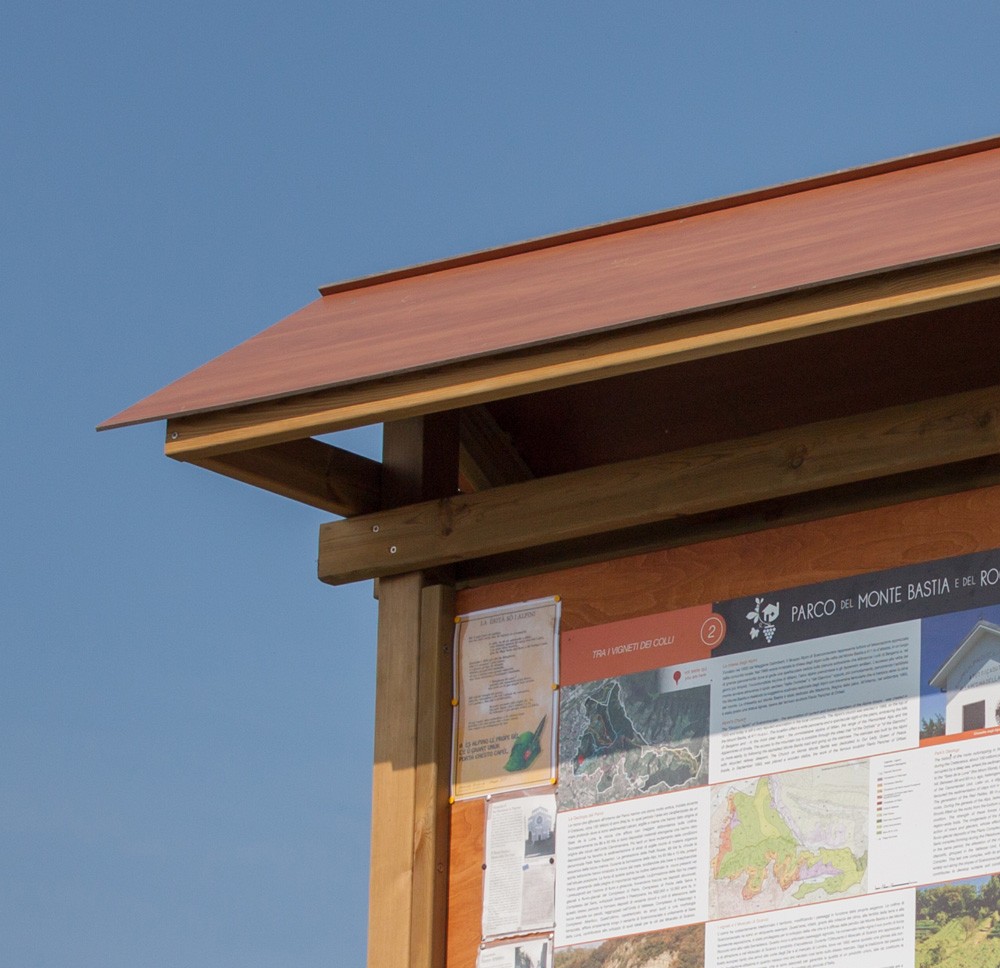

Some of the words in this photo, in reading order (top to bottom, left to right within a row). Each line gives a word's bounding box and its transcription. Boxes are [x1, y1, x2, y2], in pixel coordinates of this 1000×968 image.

[791, 599, 836, 622] PARCO
[840, 598, 854, 610] DEL
[858, 586, 902, 610] MONTE
[907, 577, 950, 601] BASTIA
[954, 578, 959, 588] E
[962, 576, 976, 587] DEL
[707, 624, 717, 639] 2
[592, 649, 606, 659] TRA
[611, 642, 639, 656] VIGNETI
[639, 640, 652, 650] DEI
[652, 636, 675, 648] COLLI
